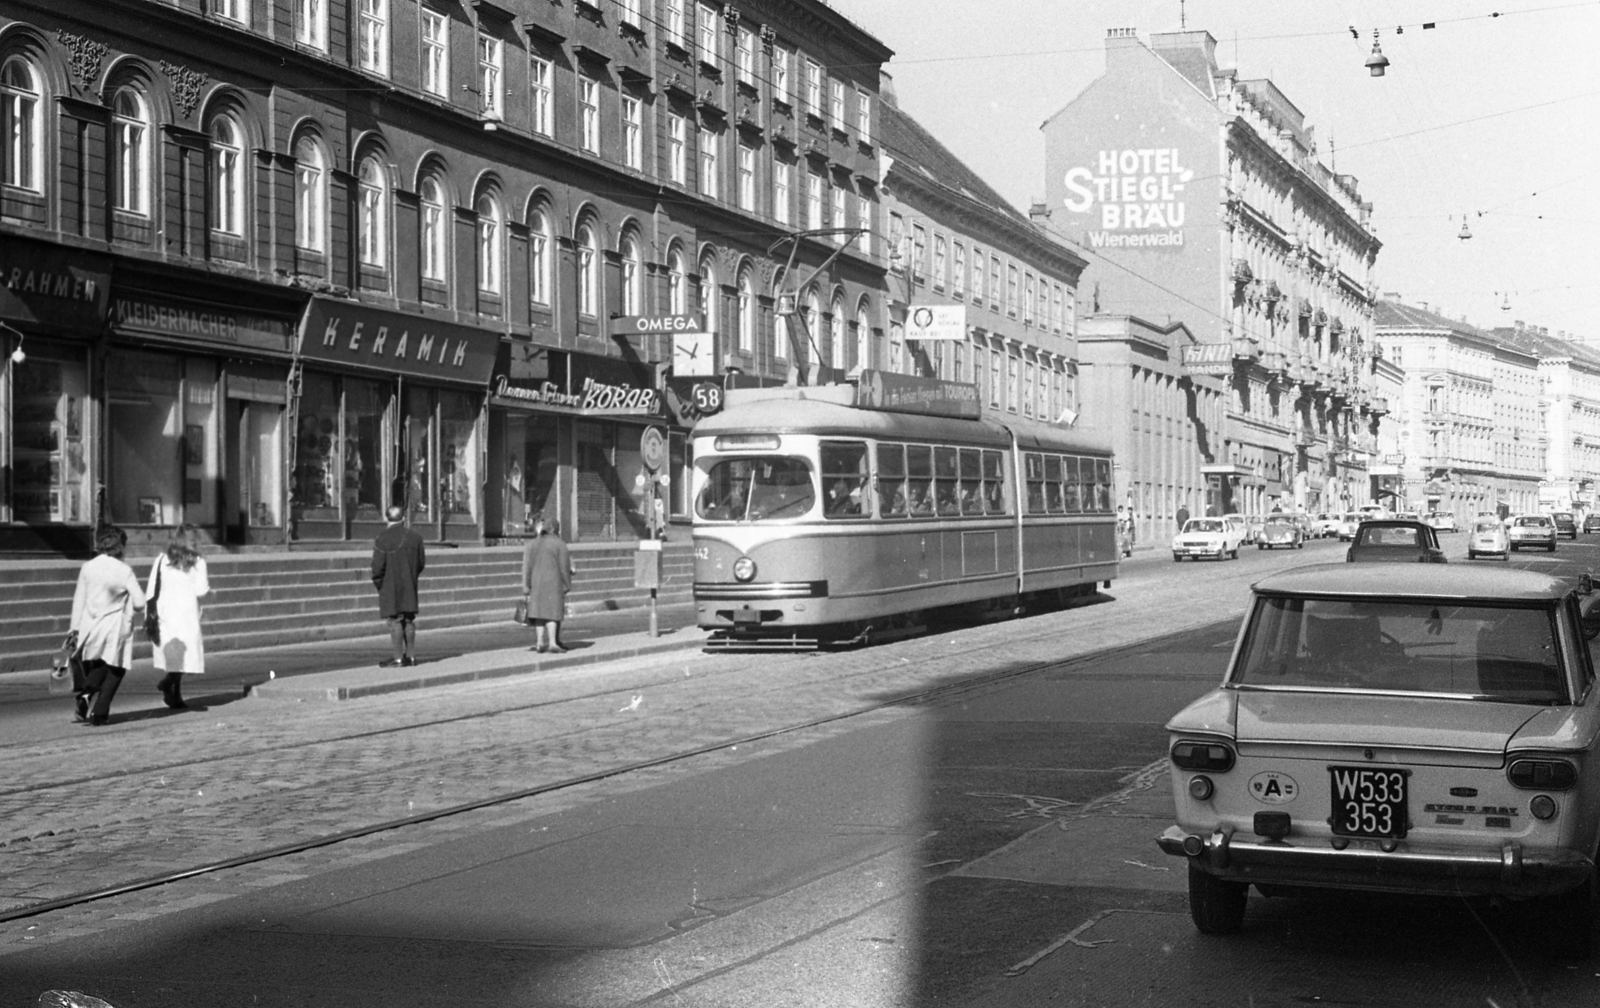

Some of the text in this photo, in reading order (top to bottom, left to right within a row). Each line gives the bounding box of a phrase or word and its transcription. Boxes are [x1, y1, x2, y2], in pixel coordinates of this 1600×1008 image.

[1099, 148, 1184, 175] HOTEL
[1064, 166, 1185, 213] STIEGL-
[1102, 202, 1185, 229] BRÄU
[1088, 230, 1183, 247] Wienerwald
[11, 267, 95, 302] RAHMEN
[117, 299, 237, 339] KLEIDERMACHER
[636, 317, 699, 331] OMEGA
[323, 318, 469, 367] KERAMIK
[696, 388, 719, 408] 58
[1264, 779, 1281, 796] A
[1333, 770, 1403, 802] W533
[1345, 803, 1392, 834] 353
